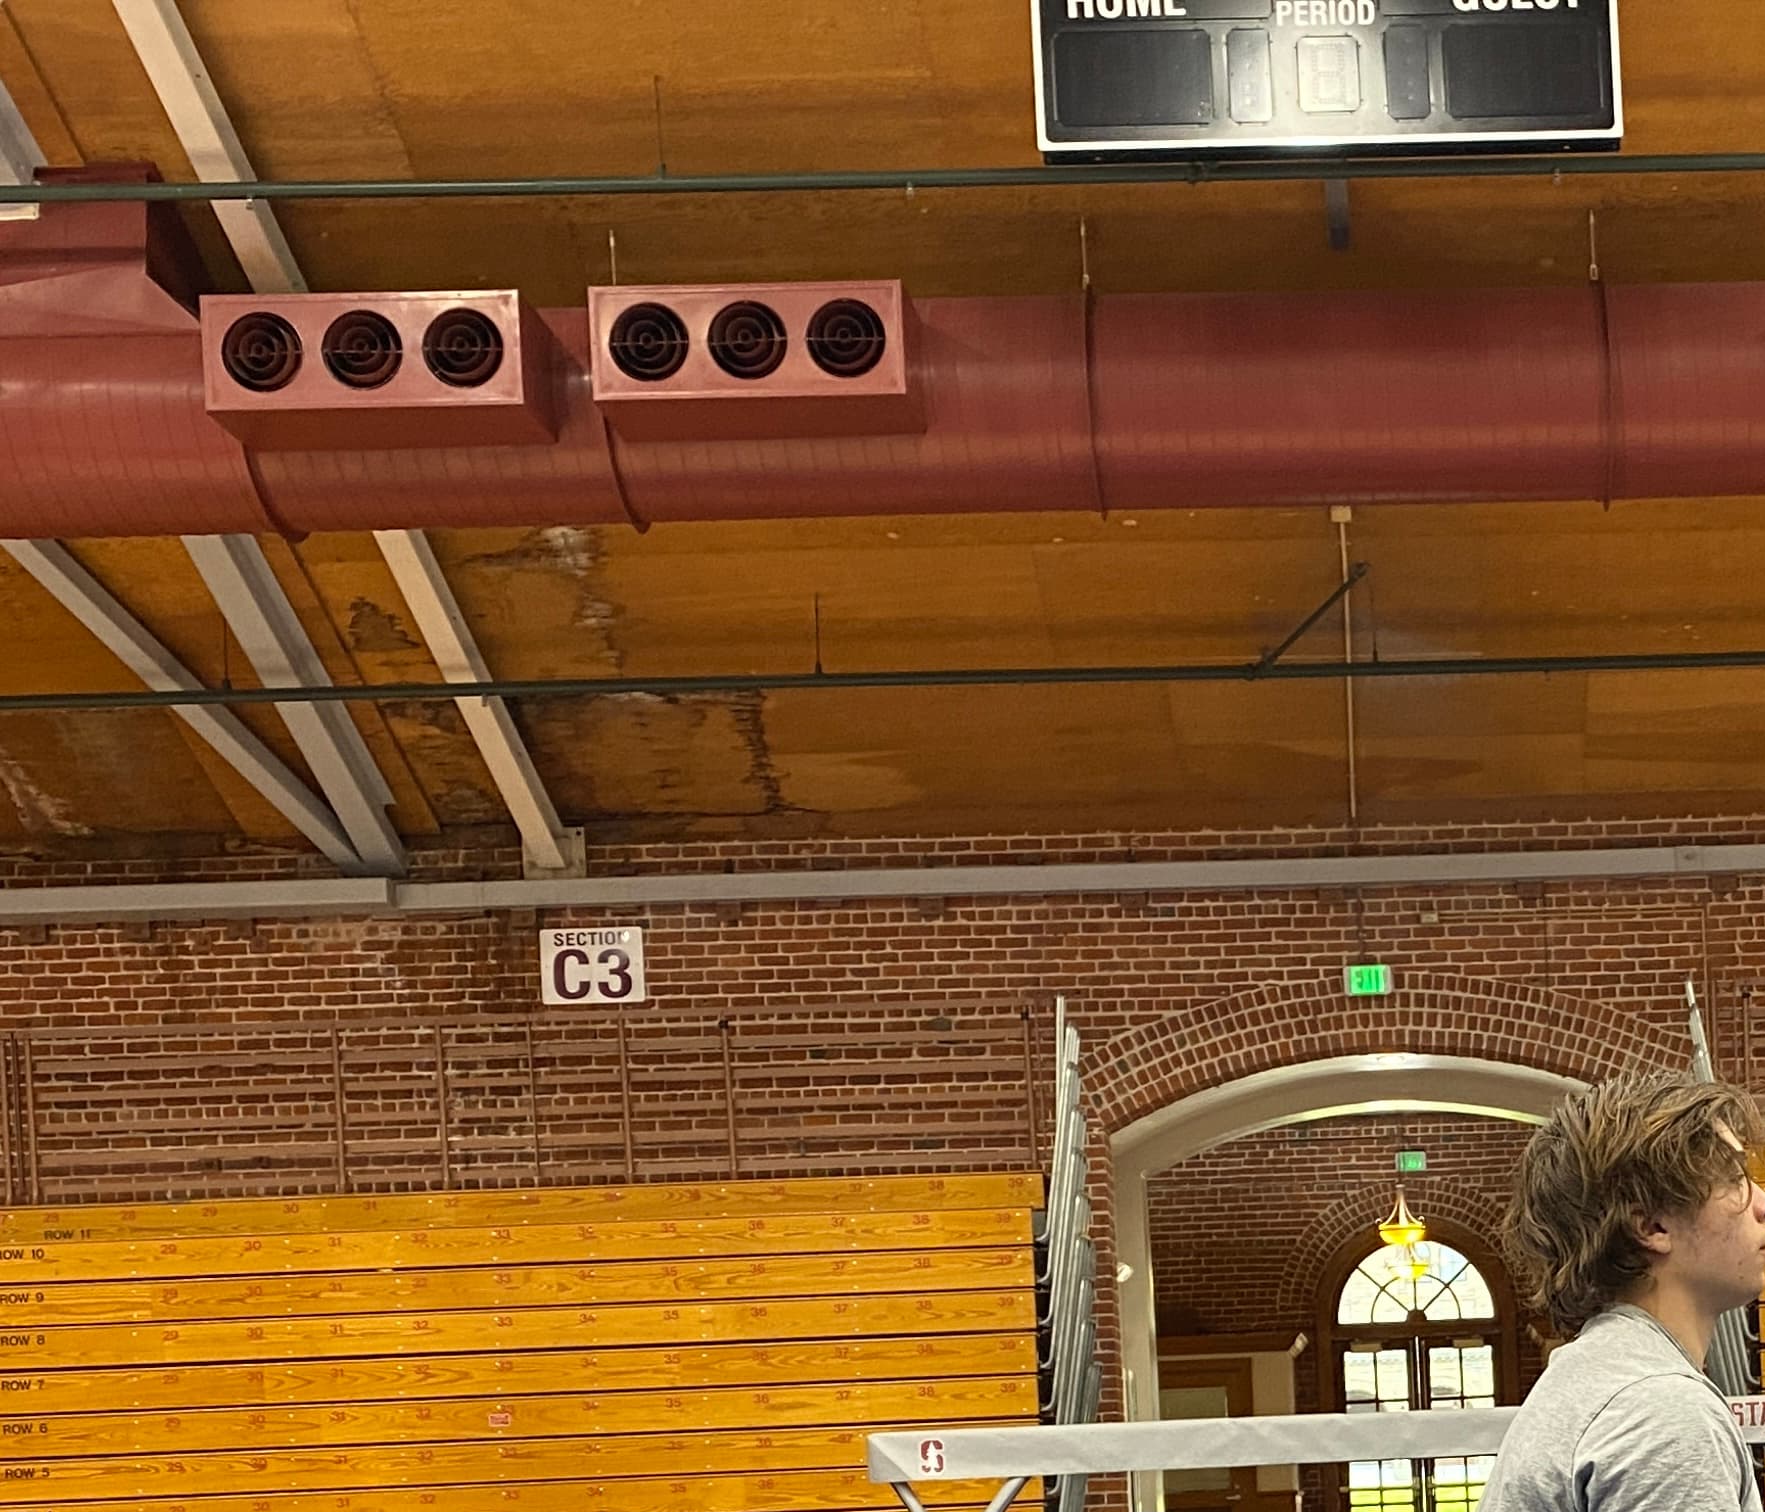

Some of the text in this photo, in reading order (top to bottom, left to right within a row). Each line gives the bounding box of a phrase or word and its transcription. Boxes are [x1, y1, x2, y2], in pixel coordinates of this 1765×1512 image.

[1276, 0, 1375, 26] PERIOD
[553, 949, 633, 999] C3
[44, 1229, 91, 1240] ROW 11
[32, 1248, 44, 1259] 10
[0, 1292, 45, 1304] ROW 9
[0, 1334, 45, 1346] ROW 8
[1, 1379, 45, 1391] ROW 7
[2, 1422, 48, 1435] ROW 6
[4, 1467, 50, 1479] ROW 5
